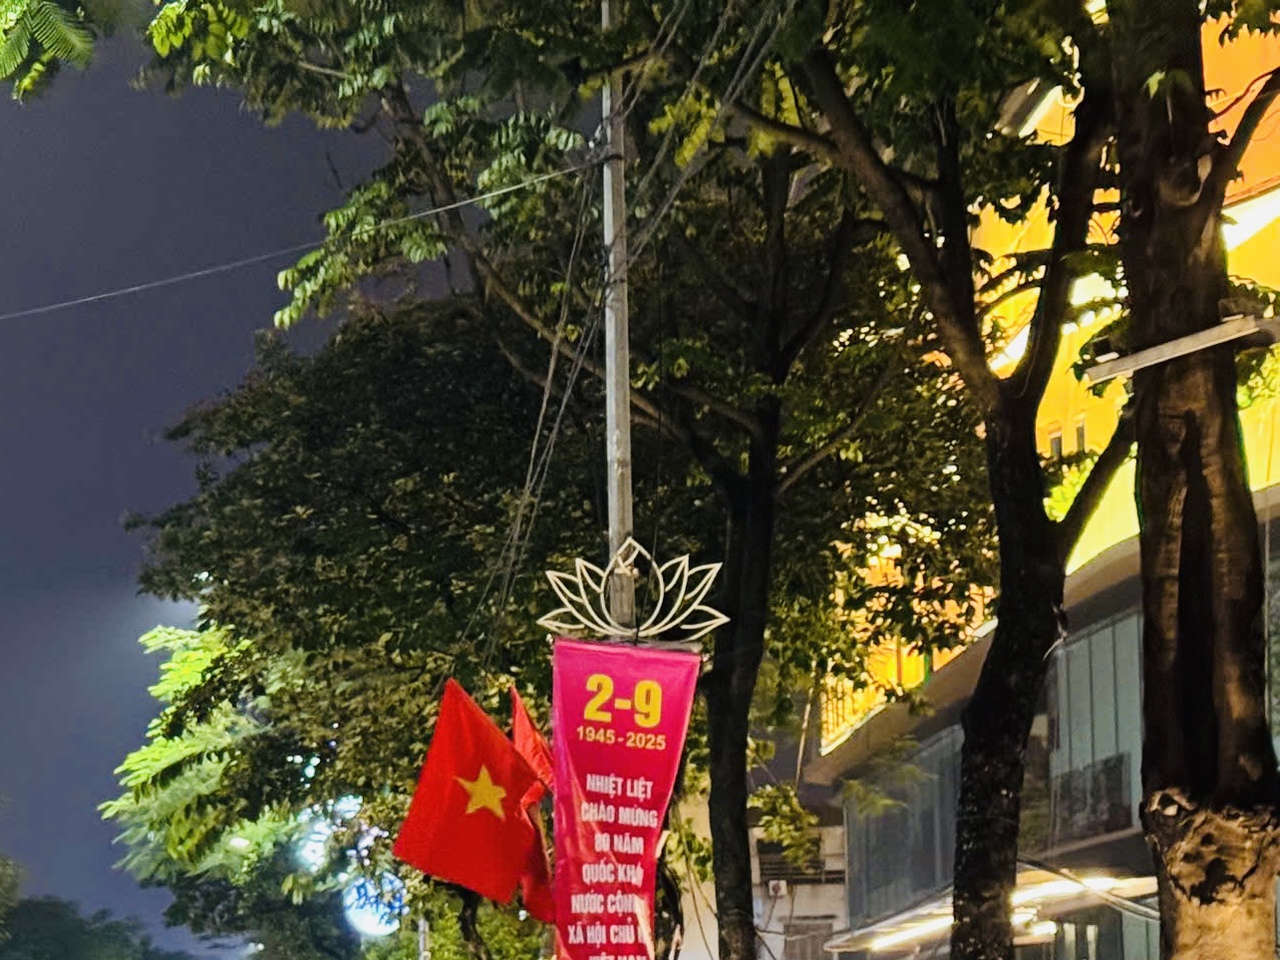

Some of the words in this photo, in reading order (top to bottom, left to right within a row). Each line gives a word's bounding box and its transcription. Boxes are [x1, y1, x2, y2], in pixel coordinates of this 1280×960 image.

[584, 673, 662, 728] 2-9
[586, 773, 623, 799] NHIỆT
[626, 776, 653, 802] LIỆT
[581, 799, 615, 823] CHÀO
[618, 804, 658, 828] MỪNG
[594, 832, 610, 852] 80
[613, 832, 644, 854] NĂM
[582, 857, 615, 885] QUỐC
[571, 889, 604, 914] NƯỚC
[567, 921, 584, 944] XÃ
[586, 921, 606, 948] HỘI
[609, 916, 635, 944] CHỦ
